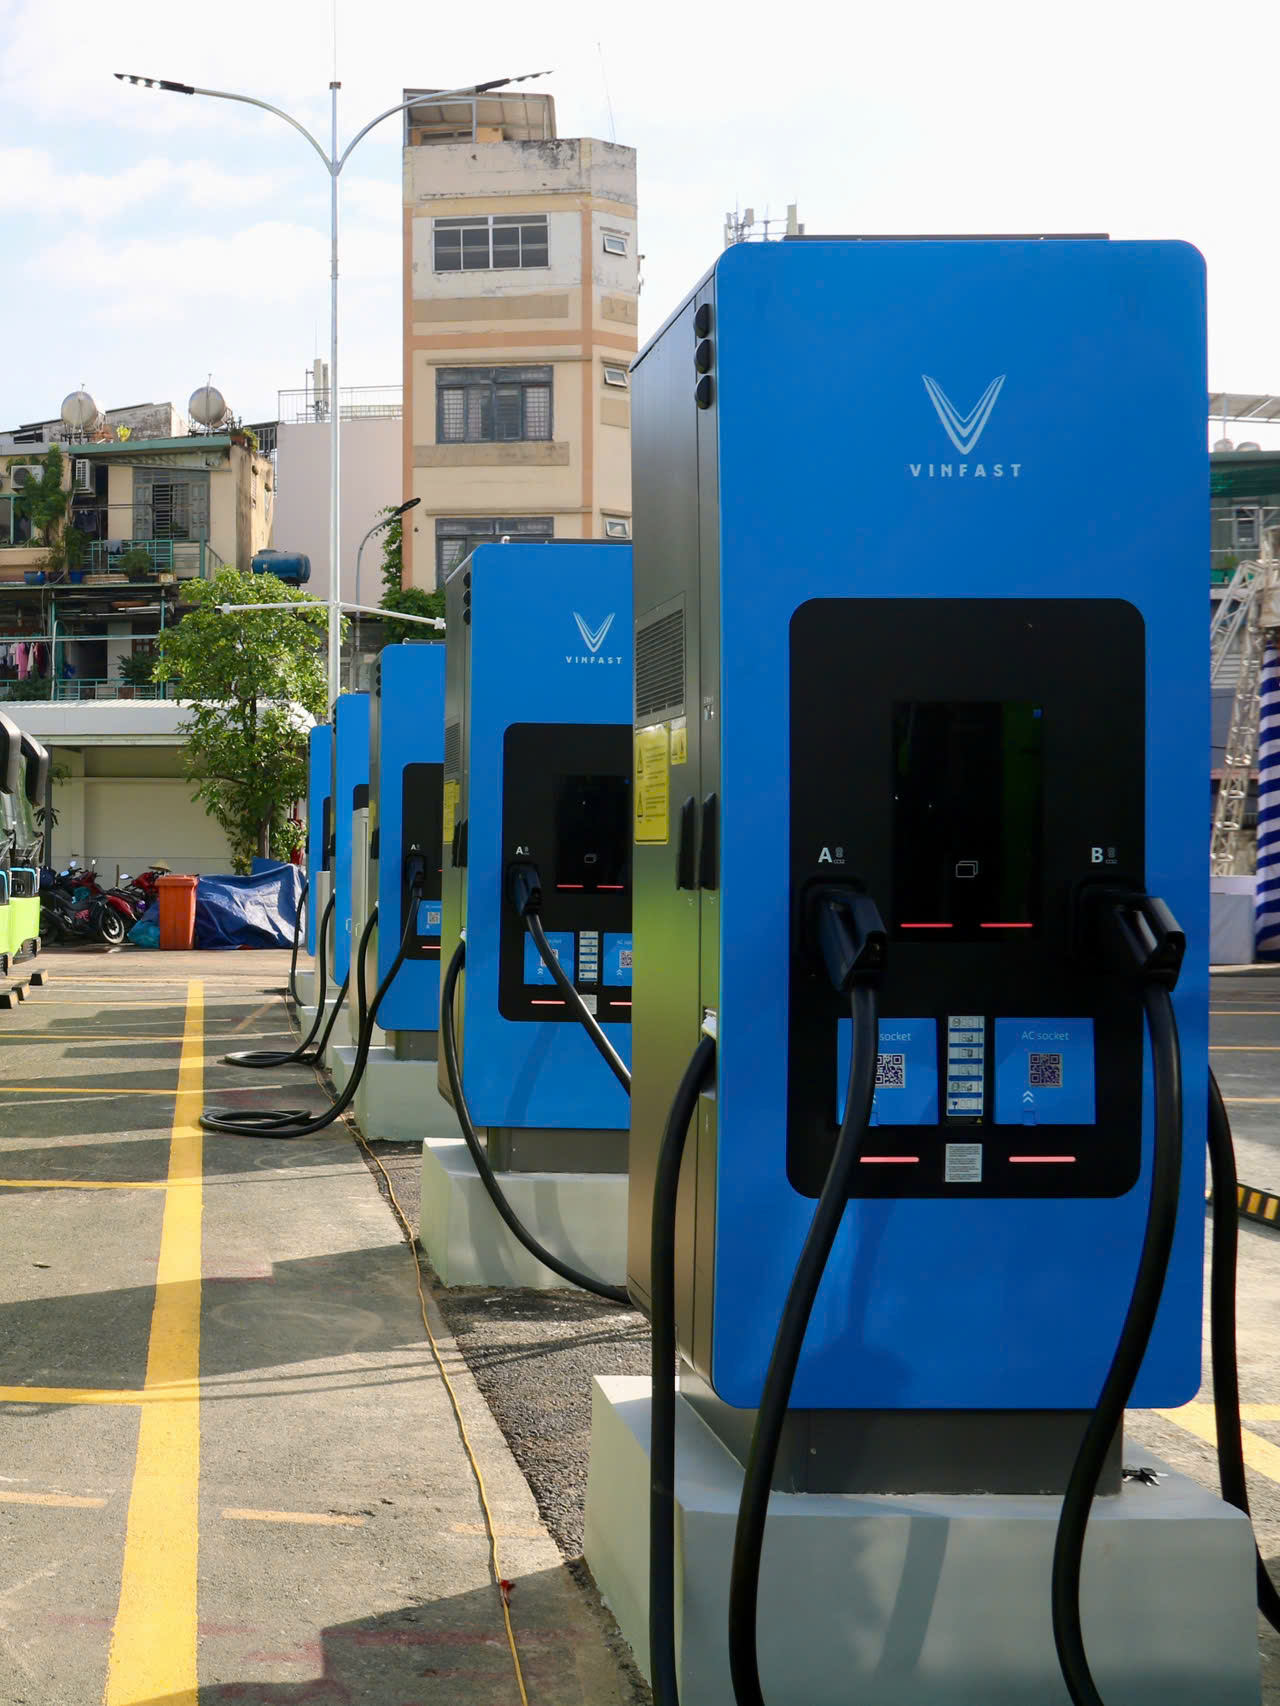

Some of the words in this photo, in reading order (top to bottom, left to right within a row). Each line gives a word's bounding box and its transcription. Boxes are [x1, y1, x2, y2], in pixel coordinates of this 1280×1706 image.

[909, 463, 1022, 478] VINFAST
[565, 656, 622, 665] VINFAST
[515, 846, 524, 855] A
[818, 847, 833, 863] A
[1091, 847, 1104, 863] B
[879, 1031, 912, 1041] socket
[1021, 1031, 1035, 1041] AC
[1037, 1031, 1071, 1041] socket
